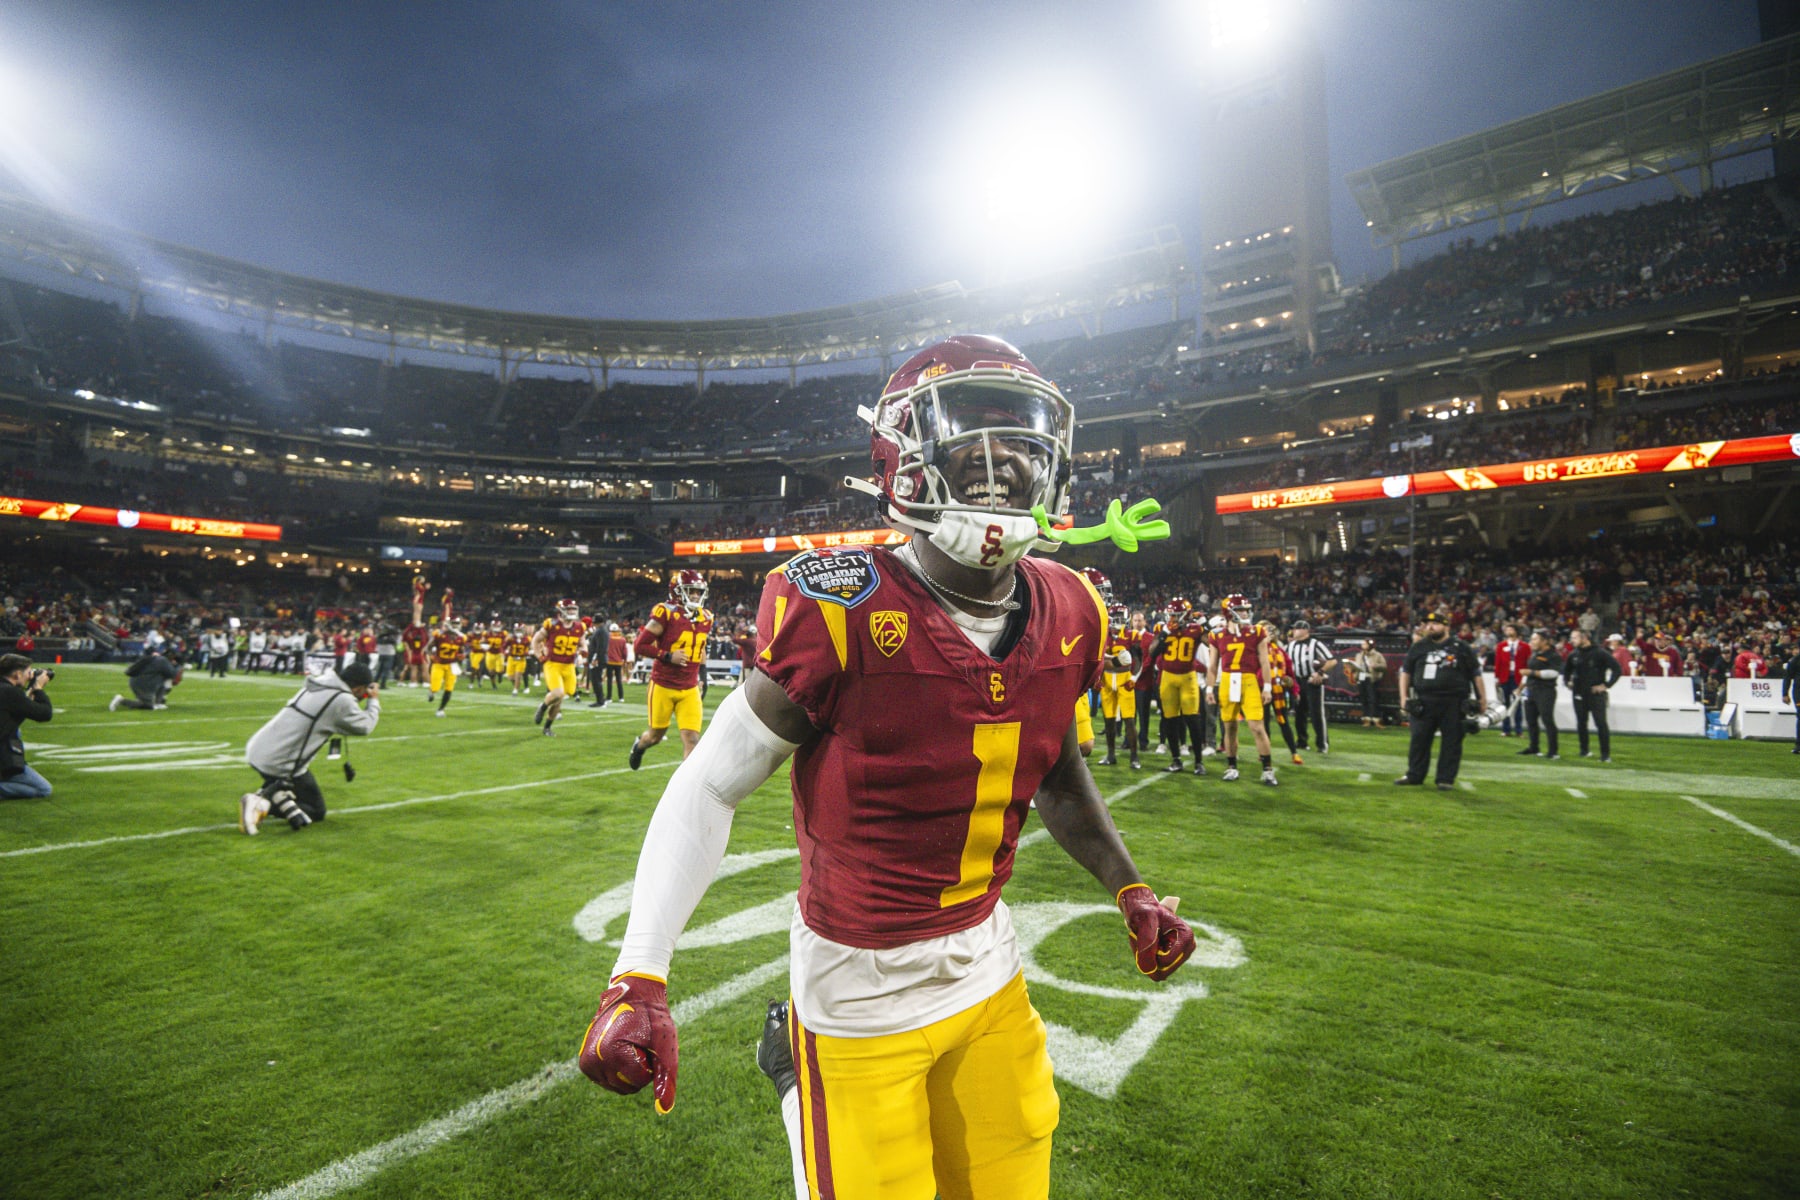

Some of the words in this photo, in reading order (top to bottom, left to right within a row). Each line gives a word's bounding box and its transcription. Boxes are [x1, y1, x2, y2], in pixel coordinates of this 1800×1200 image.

[922, 363, 947, 379] USC
[1523, 463, 1558, 481] USC
[1564, 453, 1639, 476] TROJANS
[1252, 494, 1277, 509] USC
[171, 518, 196, 532] USC
[695, 543, 711, 553] USC
[788, 554, 872, 580] DIRECTV
[807, 567, 866, 585] HOLIDAY
[820, 576, 863, 590] BOWL
[872, 612, 906, 638] PAC
[670, 630, 708, 663] 40
[880, 630, 898, 647] 12
[1163, 636, 1195, 662] 30
[1226, 642, 1245, 669] 7
[990, 673, 1005, 702] SC
[1751, 682, 1770, 690] BIG
[940, 722, 1021, 908] 1
